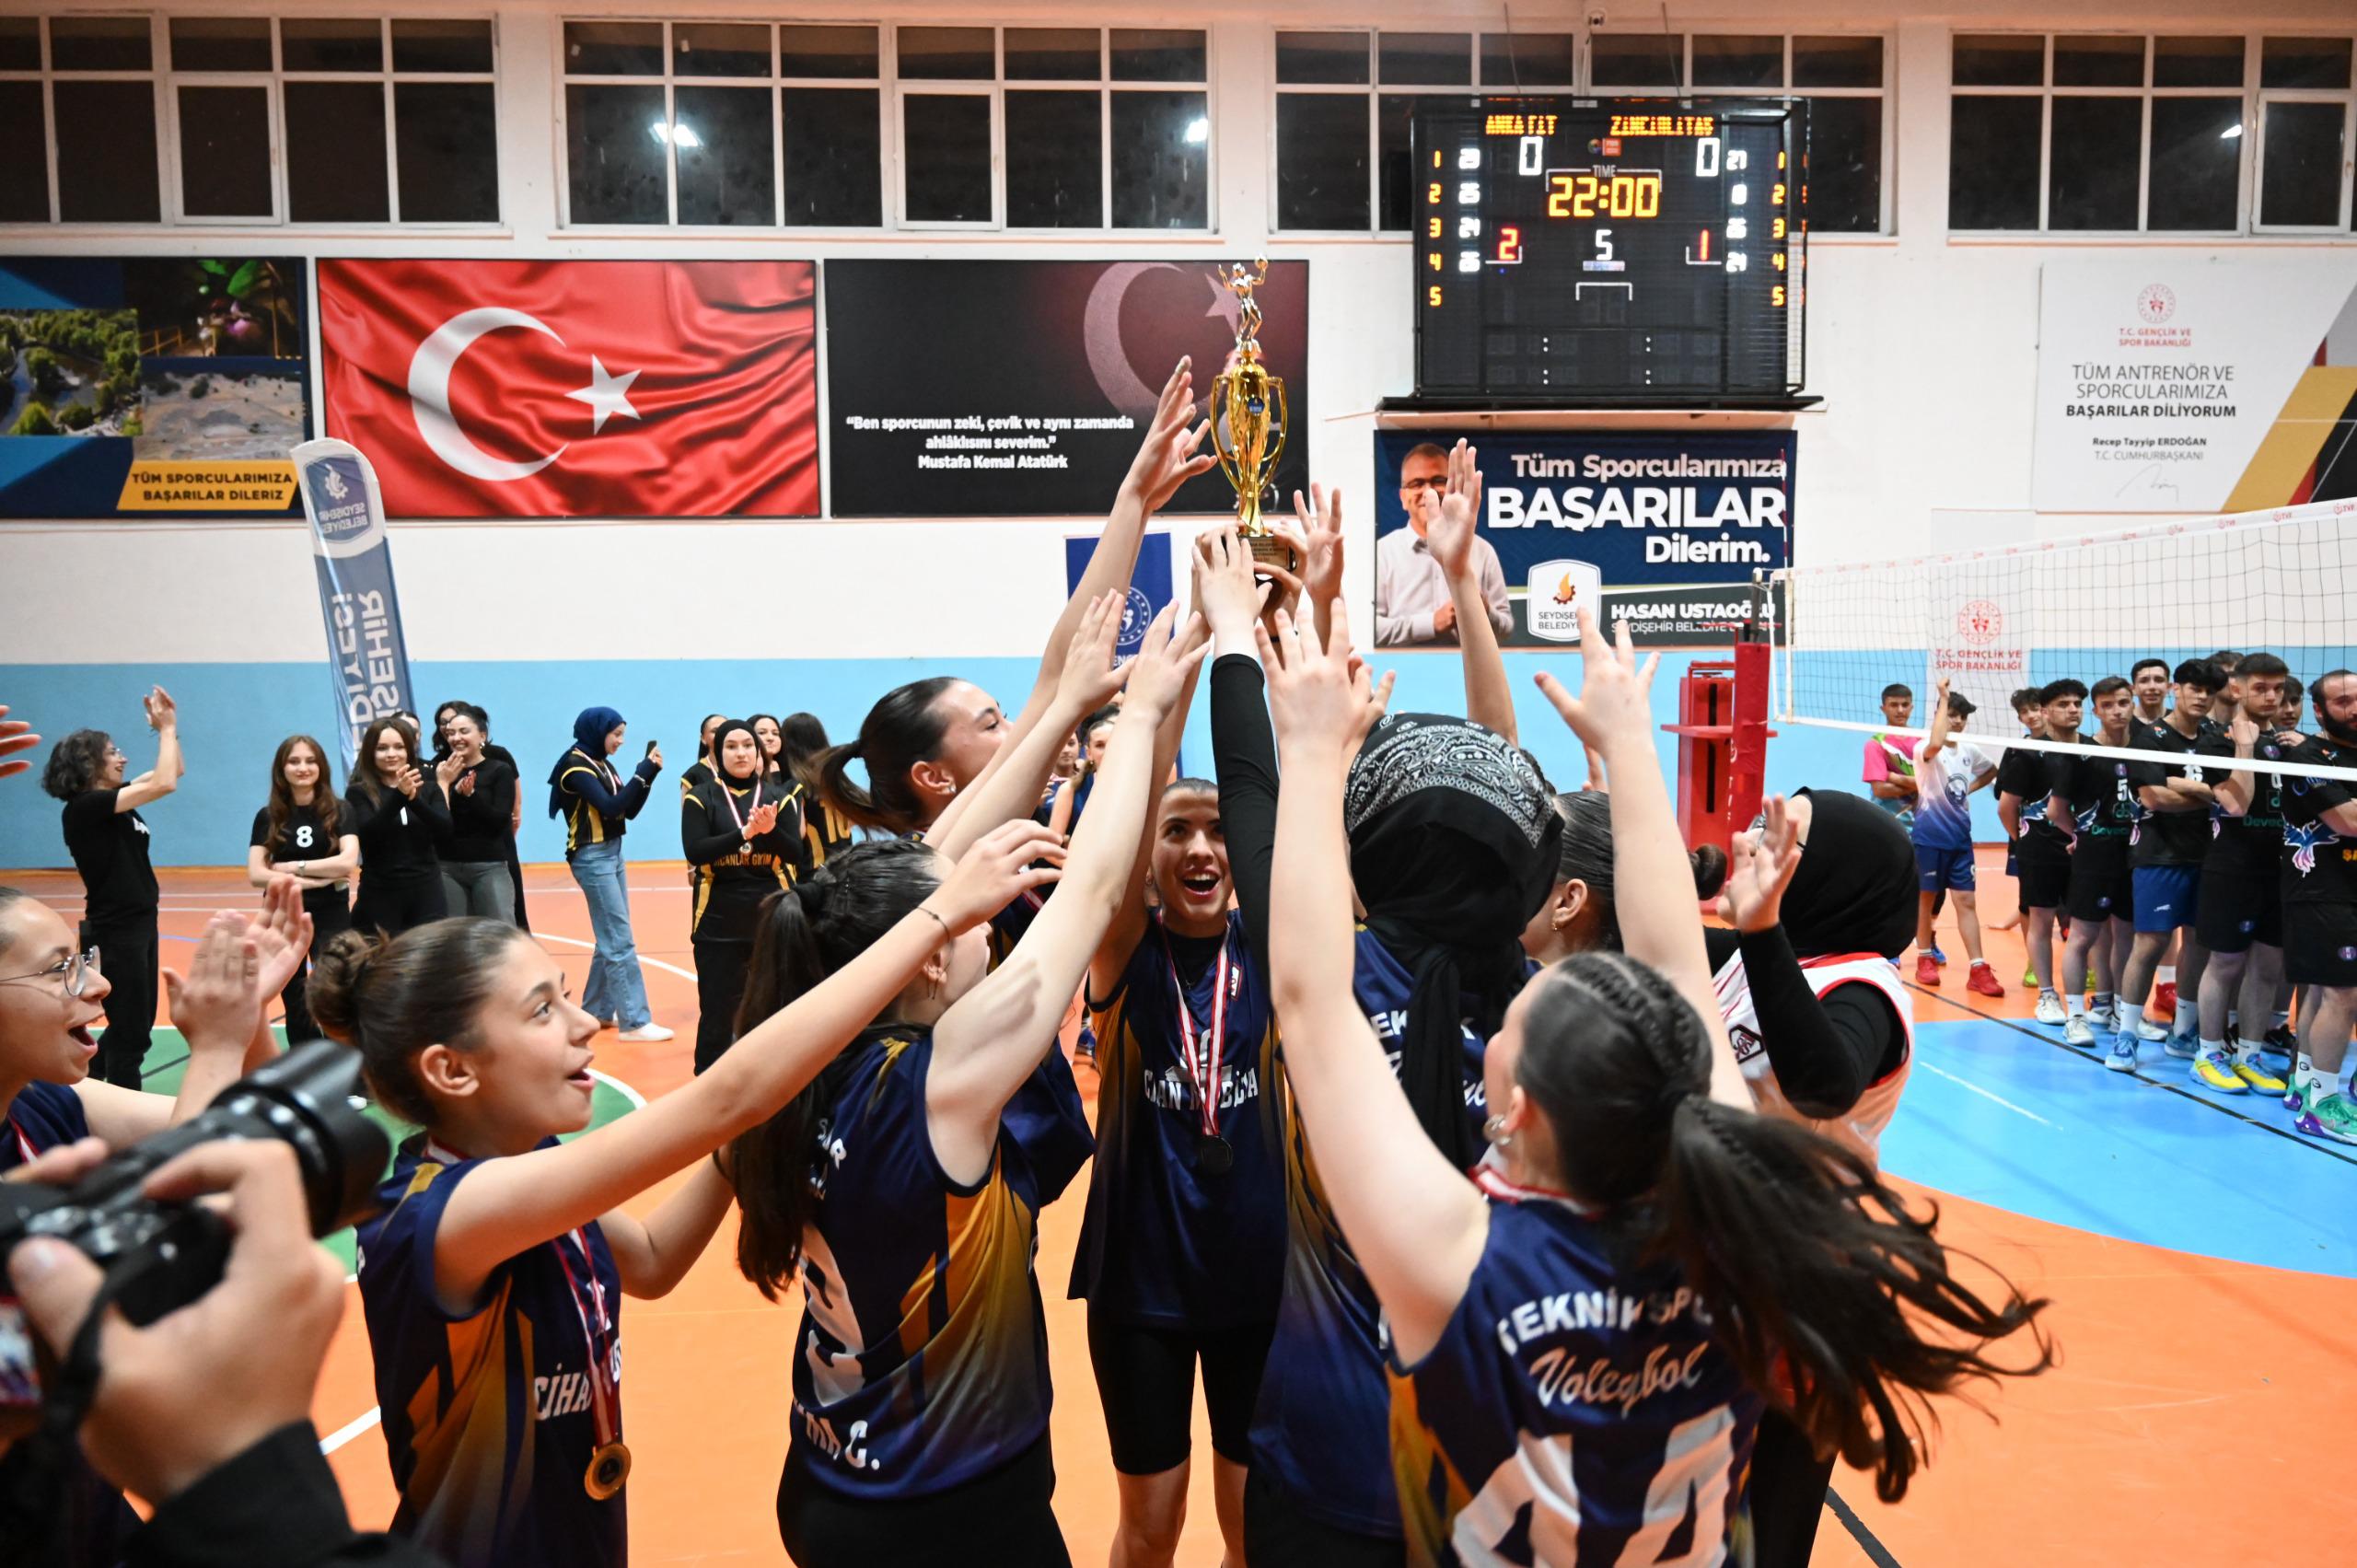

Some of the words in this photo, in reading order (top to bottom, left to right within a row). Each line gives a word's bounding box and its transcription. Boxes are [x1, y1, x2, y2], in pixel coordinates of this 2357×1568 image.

[1434, 150, 1441, 168] 1
[1519, 136, 1543, 175] 0
[1696, 137, 1720, 177] 0
[1778, 151, 1785, 169] 1
[1593, 165, 1616, 178] TIME
[1429, 183, 1441, 203] 2
[1549, 177, 1658, 217] 22:00
[1771, 184, 1784, 204] 2
[1430, 217, 1441, 238] 3
[1773, 217, 1784, 238] 3
[1499, 227, 1517, 261] 2
[1596, 229, 1613, 261] 5
[1701, 229, 1710, 261] 1
[1429, 253, 1441, 271] 4
[1772, 253, 1784, 271] 4
[1430, 286, 1441, 306] 5
[1771, 286, 1784, 306] 5
[2180, 328, 2190, 336] VE
[2073, 362, 2110, 380] TÜM
[2116, 363, 2209, 380] ANTRENÖR
[2213, 366, 2234, 380] VE
[2077, 383, 2227, 400] SPORCULARIMIZA
[2067, 404, 2149, 419] BAŞARILAR
[2154, 402, 2235, 417] DİLİYORUM
[882, 418, 952, 432] sporcunun
[954, 415, 985, 432] zeki,
[987, 415, 1022, 432] çevik
[1025, 418, 1040, 429] ve
[1043, 418, 1071, 432] aynı
[1074, 415, 1134, 429] zamanda
[2093, 437, 2120, 447] Recep
[2124, 437, 2154, 447] Tayyip
[2158, 436, 2206, 446] ERDOĞAN
[918, 455, 971, 469] Mustafa
[973, 454, 1015, 469] Kemal
[1017, 454, 1068, 469] Atatürk
[2095, 451, 2111, 460] T.C.
[2114, 451, 2203, 462] CUMHURBAŞKANI
[133, 471, 161, 483] TÜM
[167, 473, 292, 483] SPORCULARIMIZA
[1512, 453, 1574, 478] Tüm
[1583, 453, 1785, 483] Sporcularımıza
[144, 491, 224, 502] BAŞARILAR
[230, 490, 283, 500] DİLERİZ
[1488, 487, 1785, 532] BAŞARILAR
[1645, 534, 1771, 563] Dilerim.
[1611, 604, 1677, 620] HASAN
[1680, 599, 1775, 620] USTAOĞU
[2008, 649, 2022, 657] VE
[1936, 661, 1962, 669] SPOR
[296, 825, 313, 847] 8
